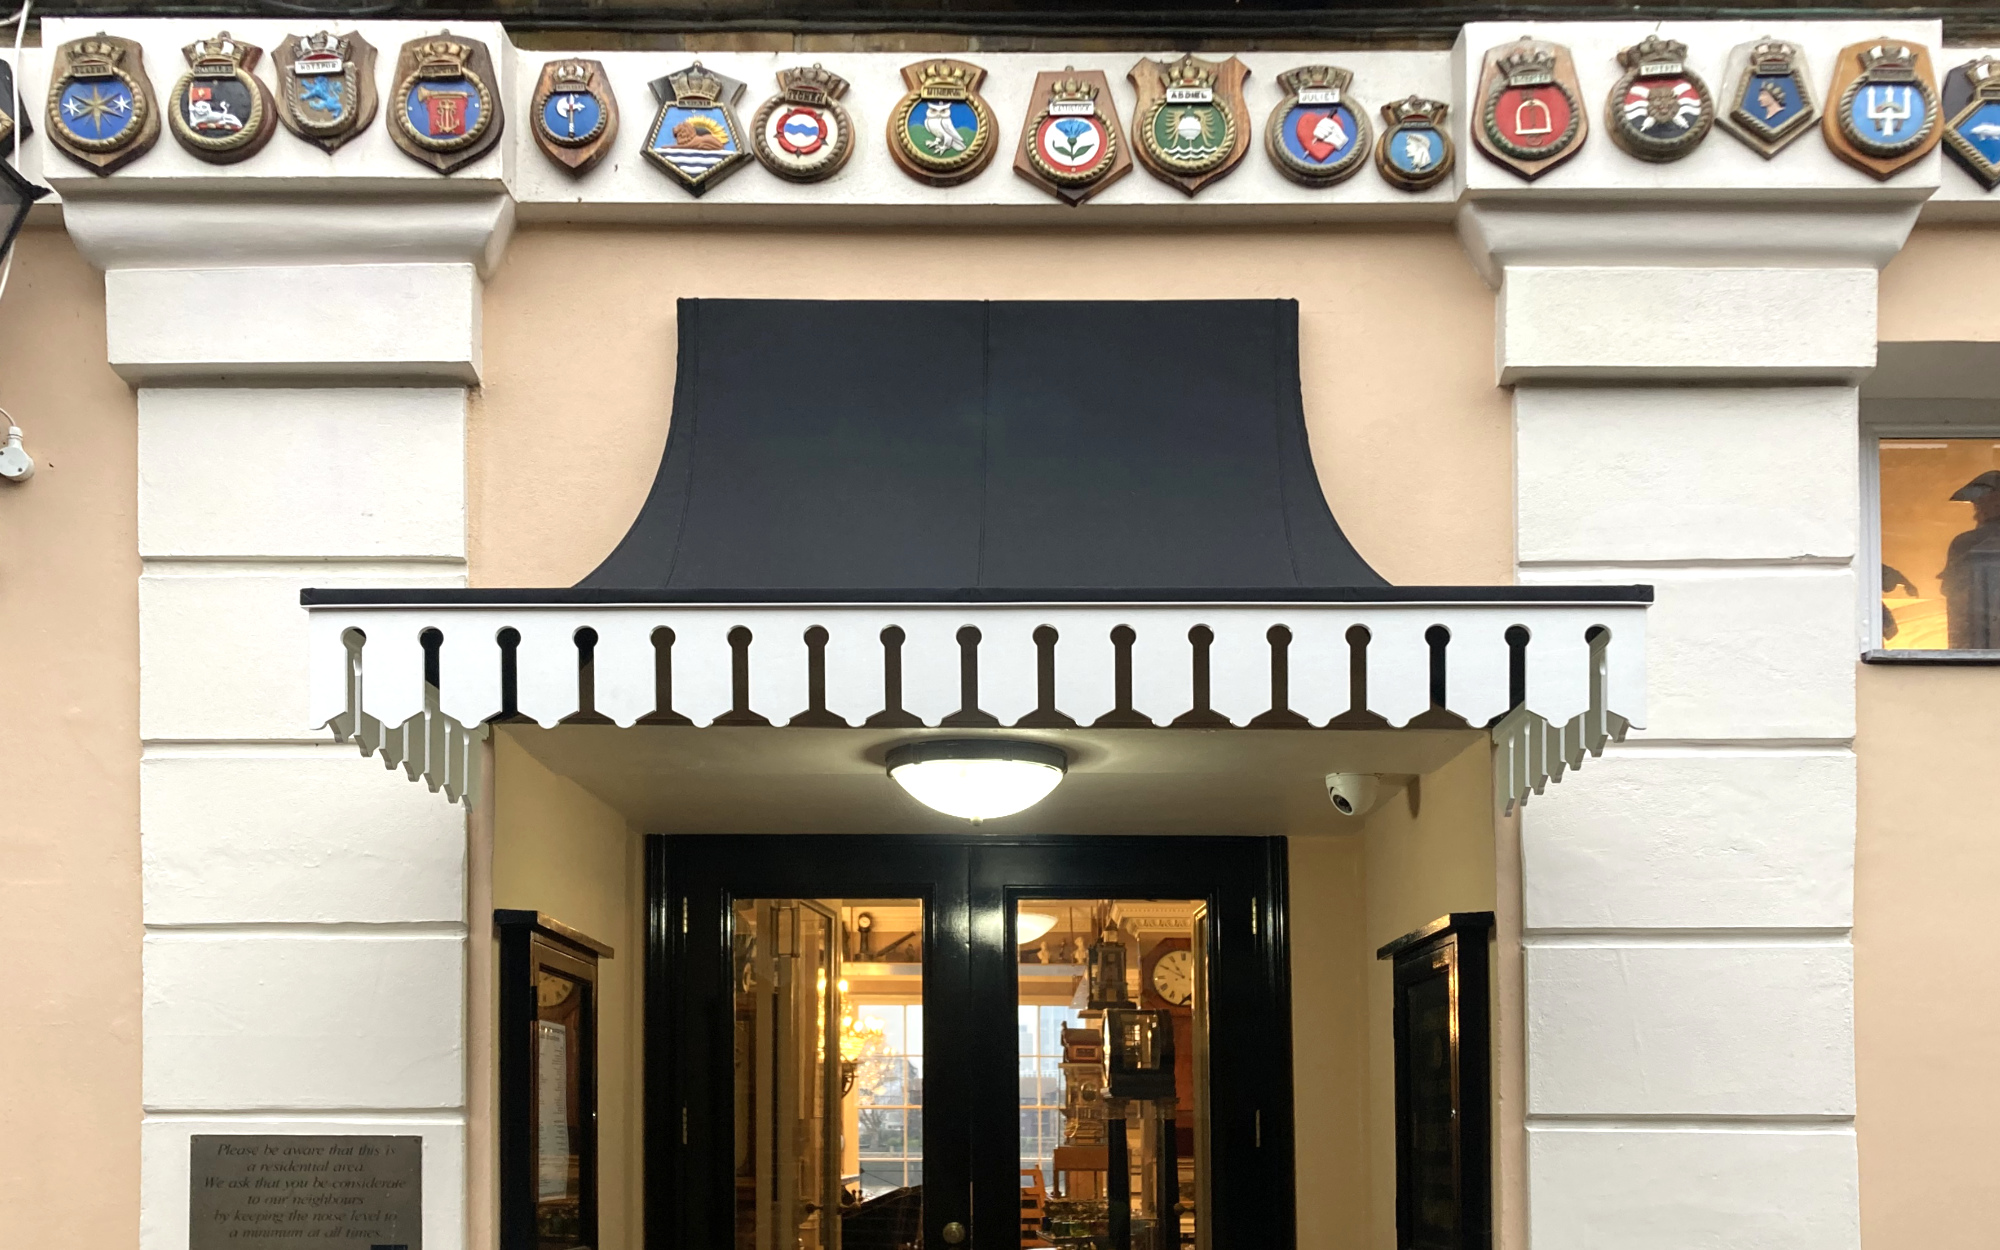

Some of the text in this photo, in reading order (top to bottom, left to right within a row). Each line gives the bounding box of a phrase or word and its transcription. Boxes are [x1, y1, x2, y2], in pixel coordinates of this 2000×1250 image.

[1171, 91, 1207, 99] ABDIEL
[1302, 92, 1336, 102] JULIET
[218, 1144, 397, 1156] Please be aware that this is
[247, 1164, 255, 1172] a
[260, 1161, 329, 1172] residential
[205, 1177, 406, 1191] We ask that you be considerate
[248, 1194, 364, 1207] to our neighbours
[214, 1211, 230, 1223] by
[234, 1210, 283, 1223] keeping
[289, 1211, 308, 1221] the
[351, 1211, 380, 1221] level
[384, 1212, 397, 1221] to
[229, 1229, 237, 1237] a
[243, 1228, 303, 1238] minimum
[307, 1228, 320, 1237] at
[324, 1226, 341, 1237] all
